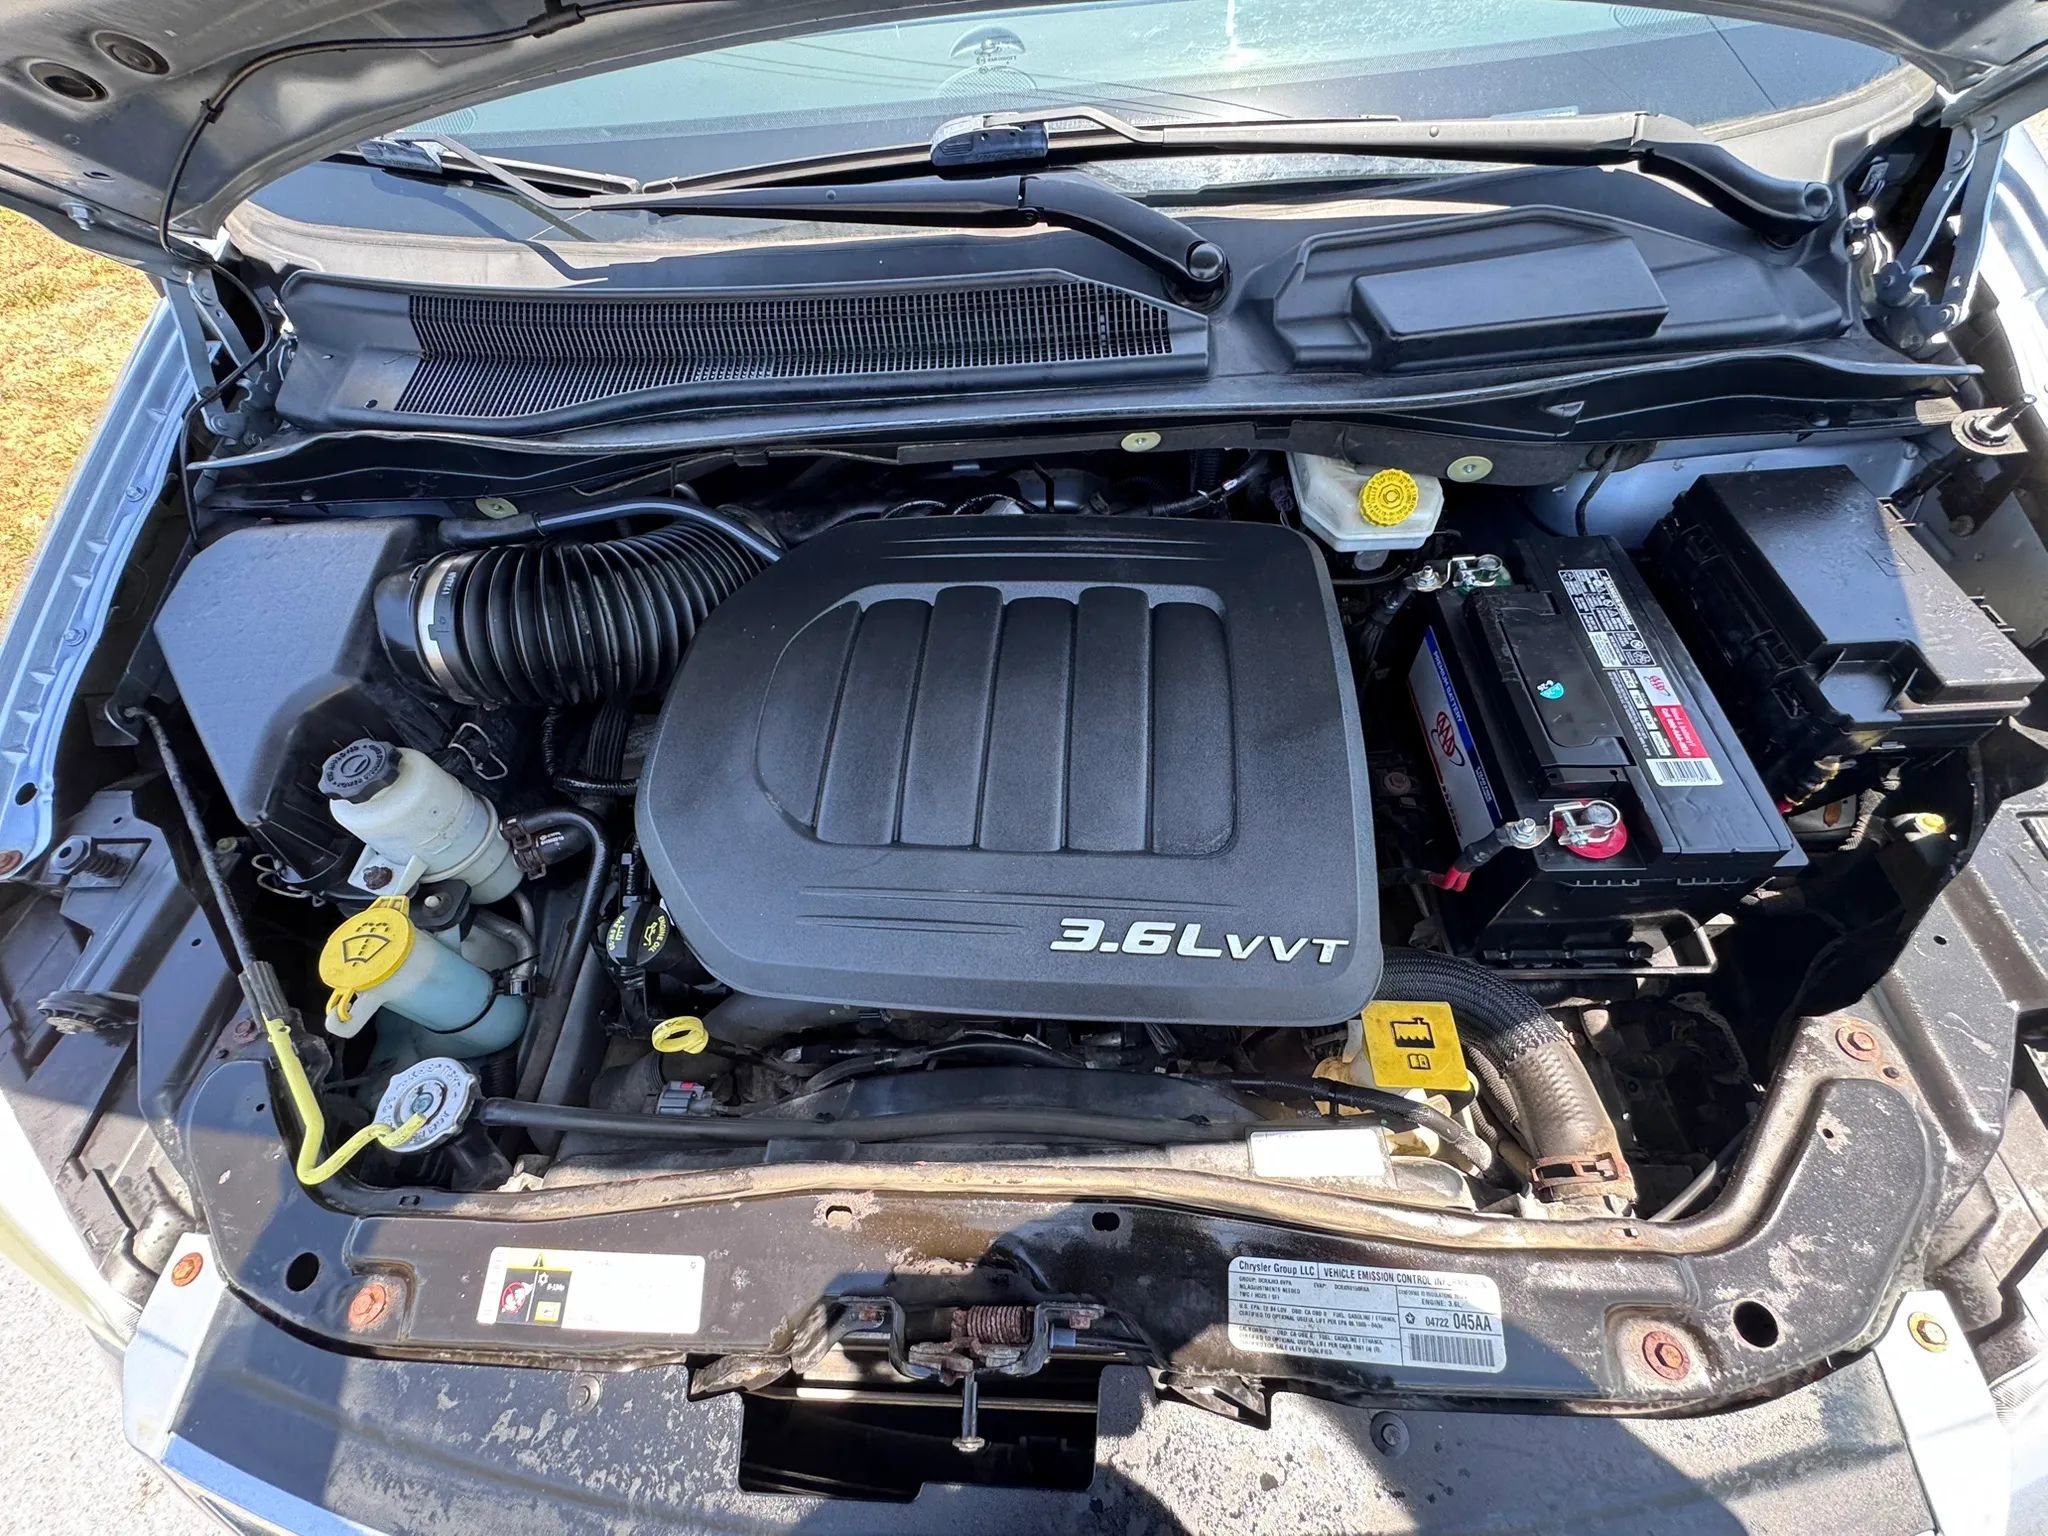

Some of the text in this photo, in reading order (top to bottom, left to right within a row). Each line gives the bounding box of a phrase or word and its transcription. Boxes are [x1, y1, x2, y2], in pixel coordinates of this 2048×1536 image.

[1433, 650, 1463, 723] PREMIUM BATTERY
[1224, 934, 1350, 964] VVT
[1239, 1260, 1314, 1275] Chrysler Group LLC
[1324, 1267, 1354, 1278] VEHICLE
[1357, 1270, 1393, 1281] EMISSION
[1396, 1273, 1430, 1284] CONTROL
[1425, 1313, 1492, 1331] 04722 045AA
